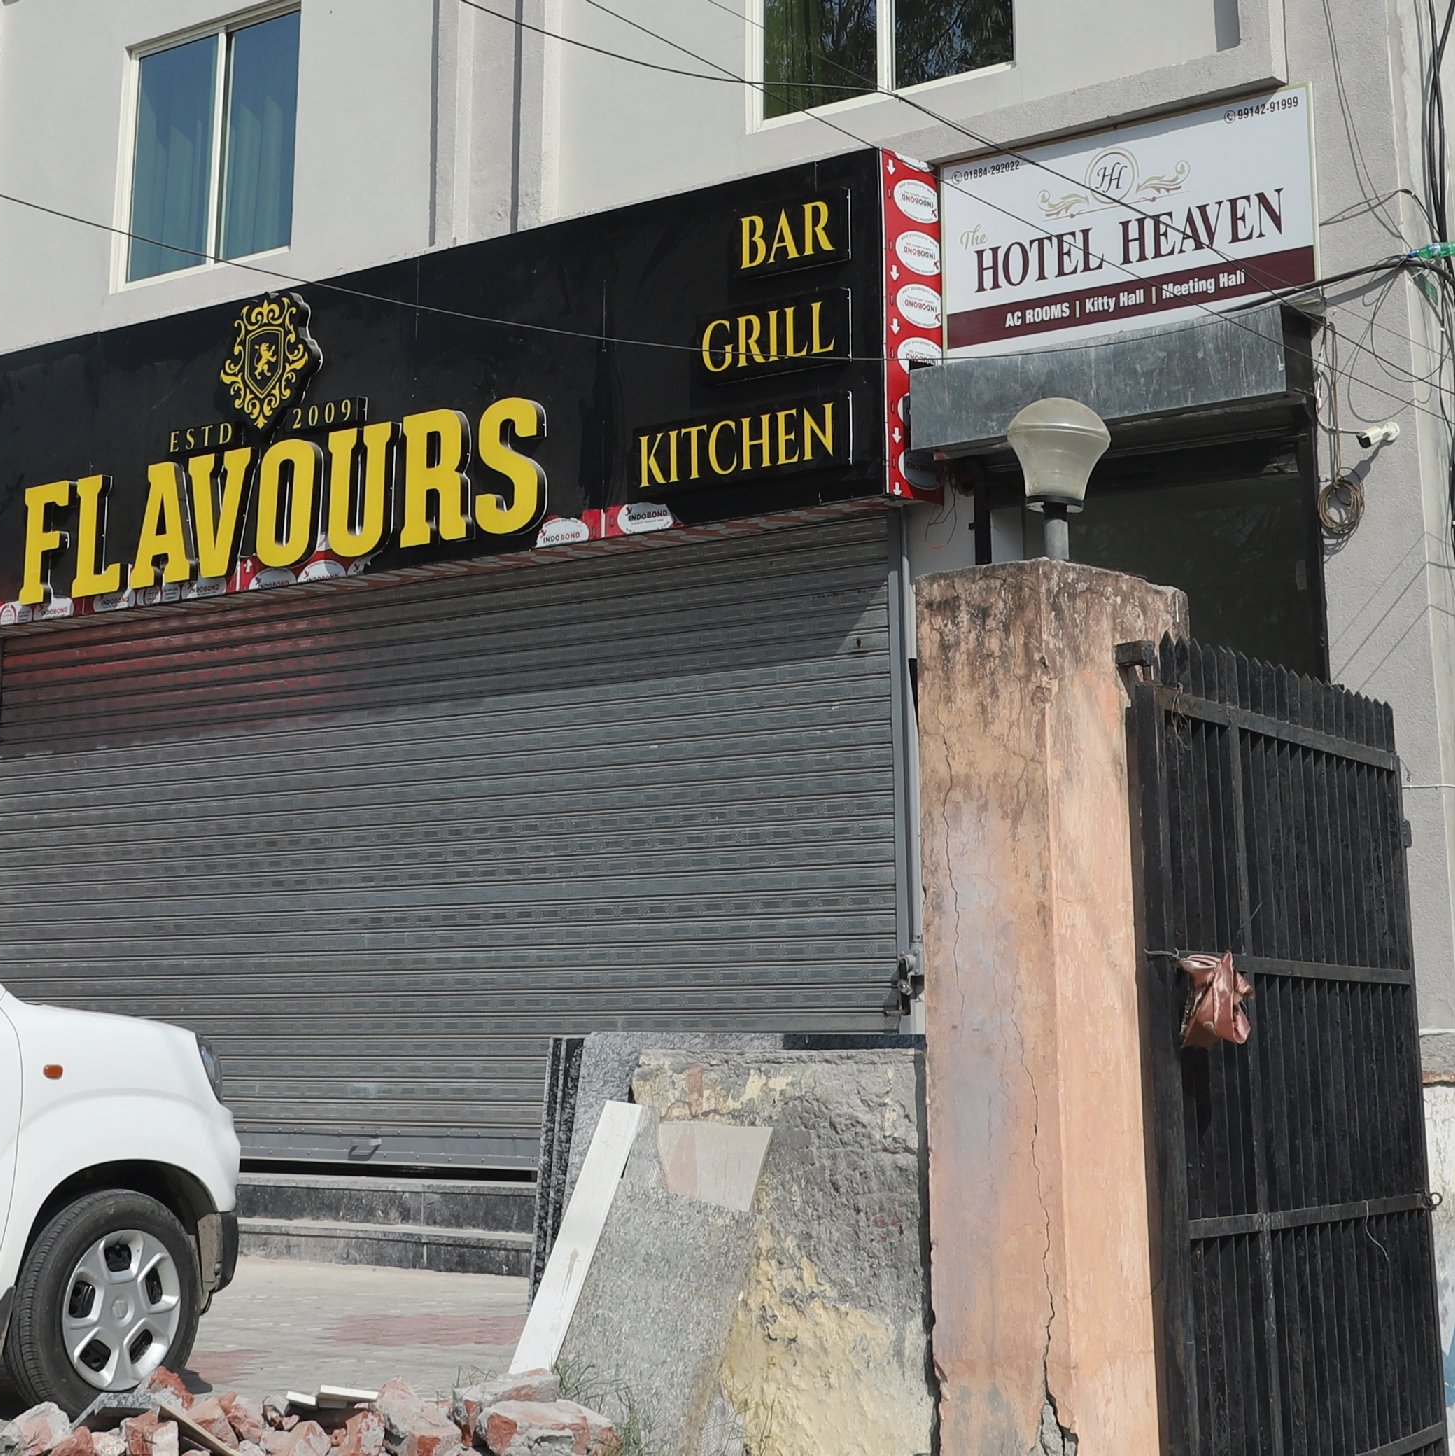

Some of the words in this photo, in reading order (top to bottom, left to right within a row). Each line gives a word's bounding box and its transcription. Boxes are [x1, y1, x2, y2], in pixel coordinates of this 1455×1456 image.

[1237, 96, 1300, 121] 99142-91999
[963, 160, 1020, 182] 01884-292022
[739, 199, 835, 272] BAR
[959, 224, 989, 251] The
[974, 227, 1105, 294] HOTEL
[1118, 187, 1285, 266] HEAVEN
[1004, 311, 1023, 328] AC
[1025, 302, 1071, 324] ROOMS
[1085, 293, 1116, 315] Kitty
[1119, 284, 1144, 305] Hall
[1162, 275, 1215, 300] Meeting
[1219, 268, 1246, 288] Hall
[700, 300, 836, 375] GRILL
[169, 421, 233, 453] ESTD
[291, 398, 352, 430] 2009
[637, 401, 836, 490] KITCHEN
[17, 396, 543, 607] FLAVOURS
[628, 509, 668, 522] INDOBOND
[542, 530, 582, 544] INDOBOND
